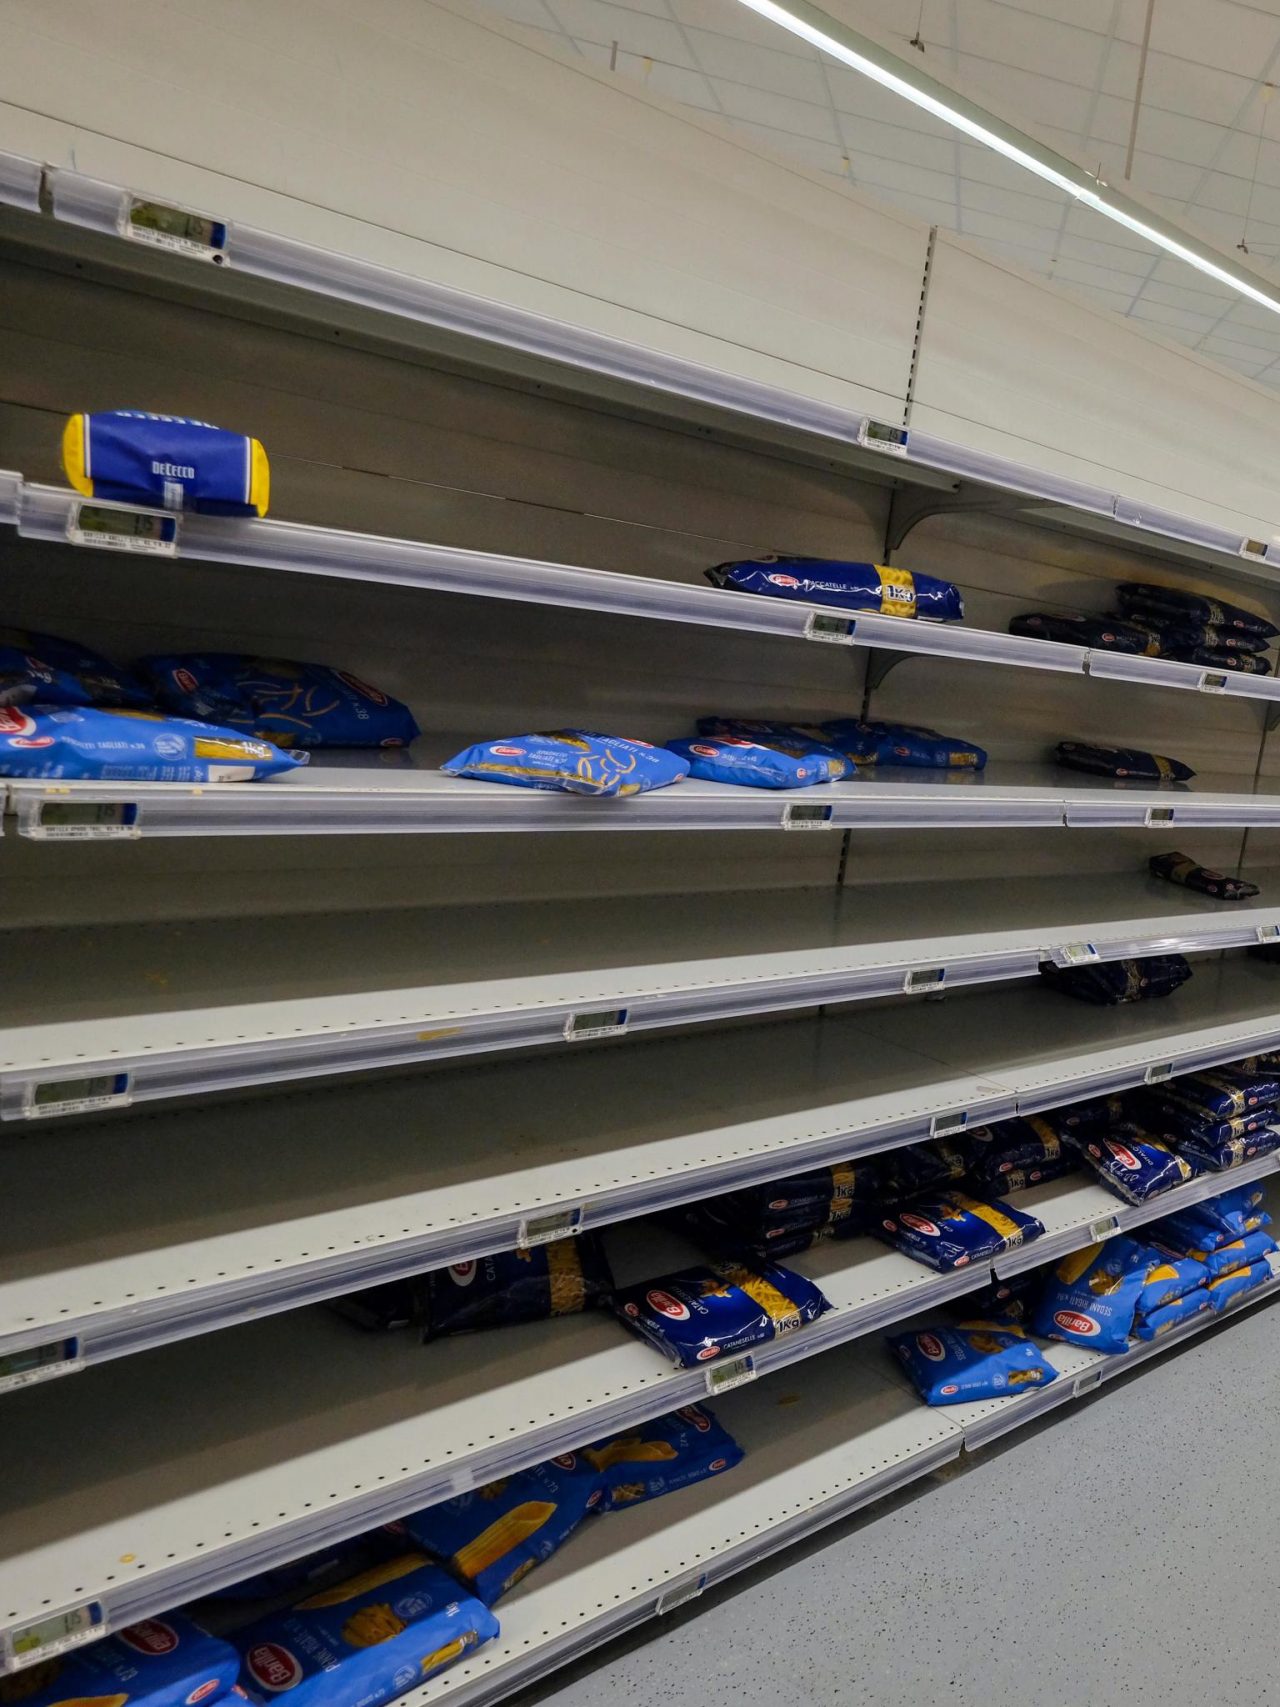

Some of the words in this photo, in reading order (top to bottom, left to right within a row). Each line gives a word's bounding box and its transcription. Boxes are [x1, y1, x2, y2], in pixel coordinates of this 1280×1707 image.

[777, 1317, 799, 1333] 1Kg
[1057, 1314, 1091, 1332] Barilla
[254, 1646, 292, 1682] Barilla
